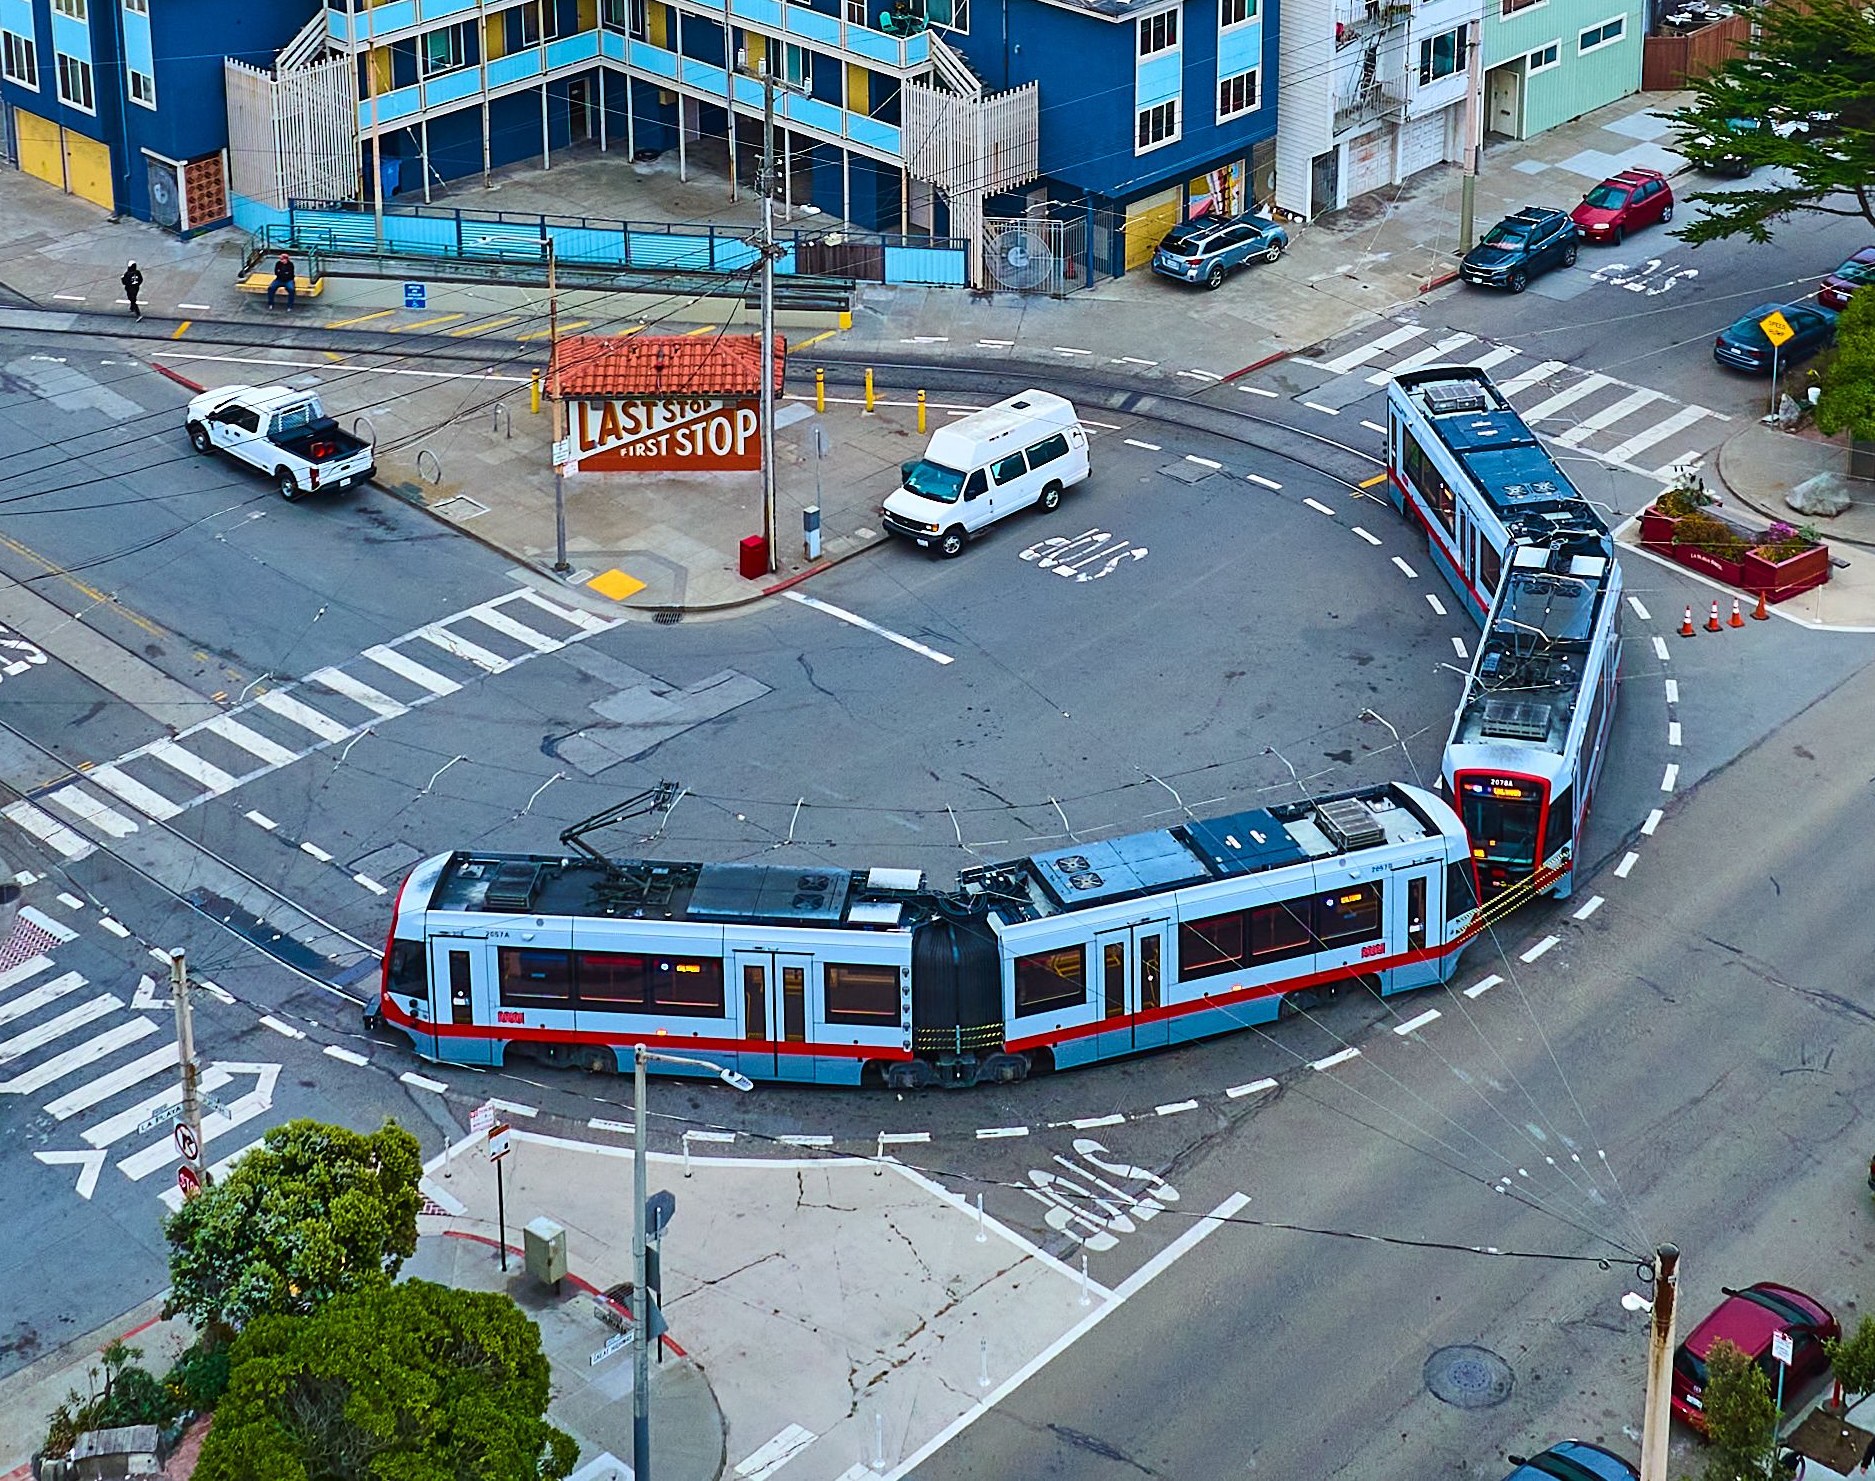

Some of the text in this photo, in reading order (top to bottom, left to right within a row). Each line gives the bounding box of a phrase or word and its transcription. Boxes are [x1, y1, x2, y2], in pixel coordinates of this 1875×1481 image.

[578, 399, 712, 452] LAST STOP
[620, 408, 758, 457] FIRST STOP
[1018, 528, 1149, 582] STOP
[141, 1121, 152, 1131] LA
[155, 1105, 181, 1123] PLAYA
[1013, 1138, 1181, 1252] STOP
